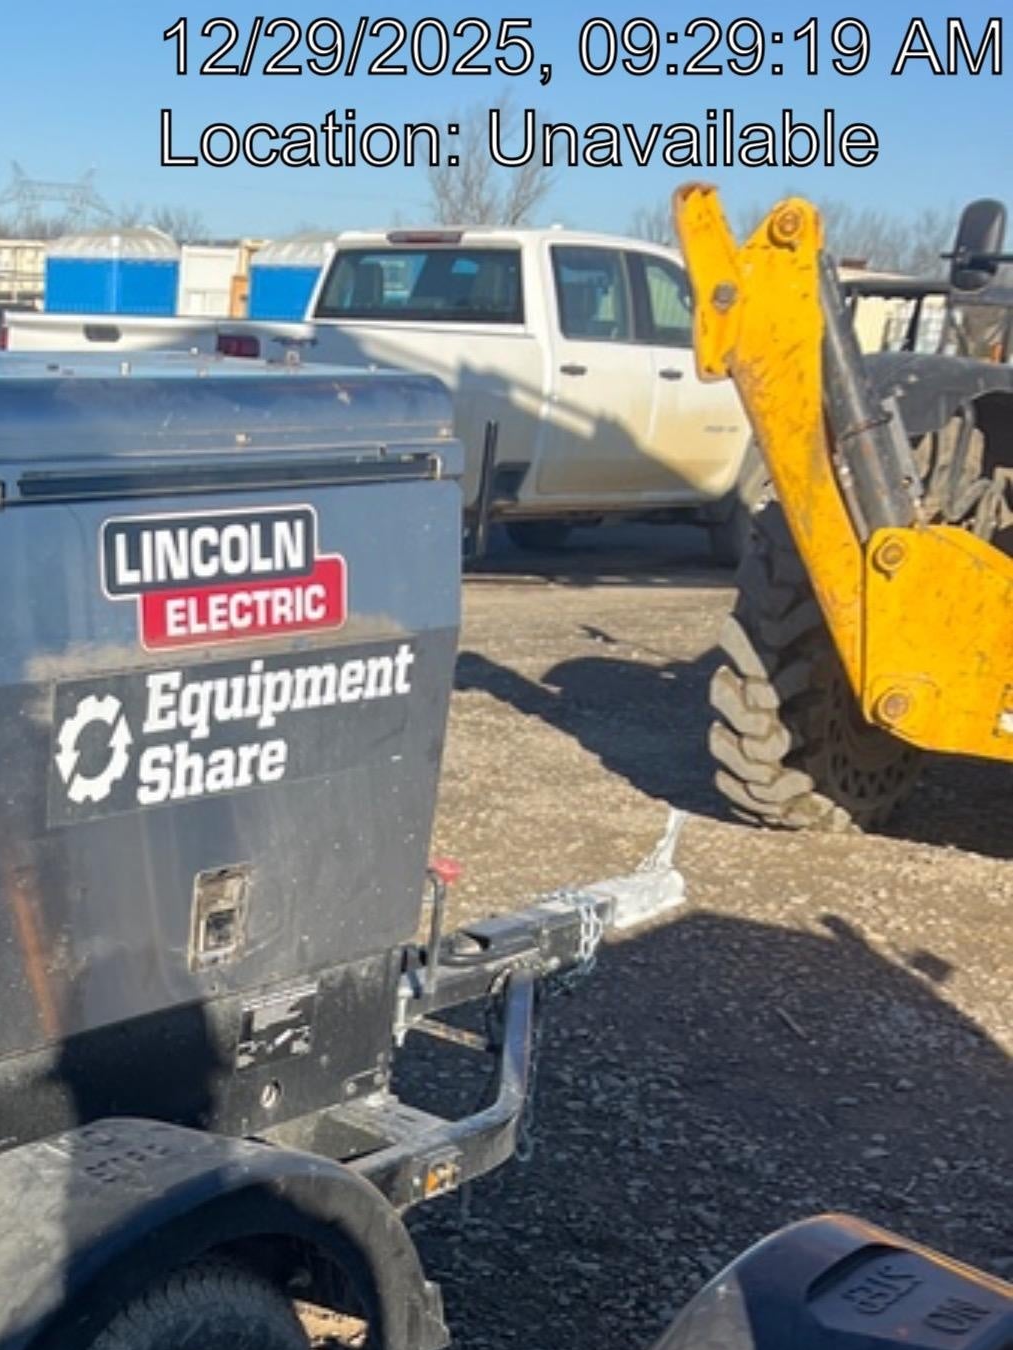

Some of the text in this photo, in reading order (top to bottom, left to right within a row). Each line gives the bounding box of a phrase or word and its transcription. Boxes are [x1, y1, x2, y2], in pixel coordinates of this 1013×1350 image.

[115, 519, 305, 585] LINCOLN
[166, 584, 326, 637] ELECTRIC
[142, 645, 415, 739] Equipment
[137, 738, 288, 805] Share
